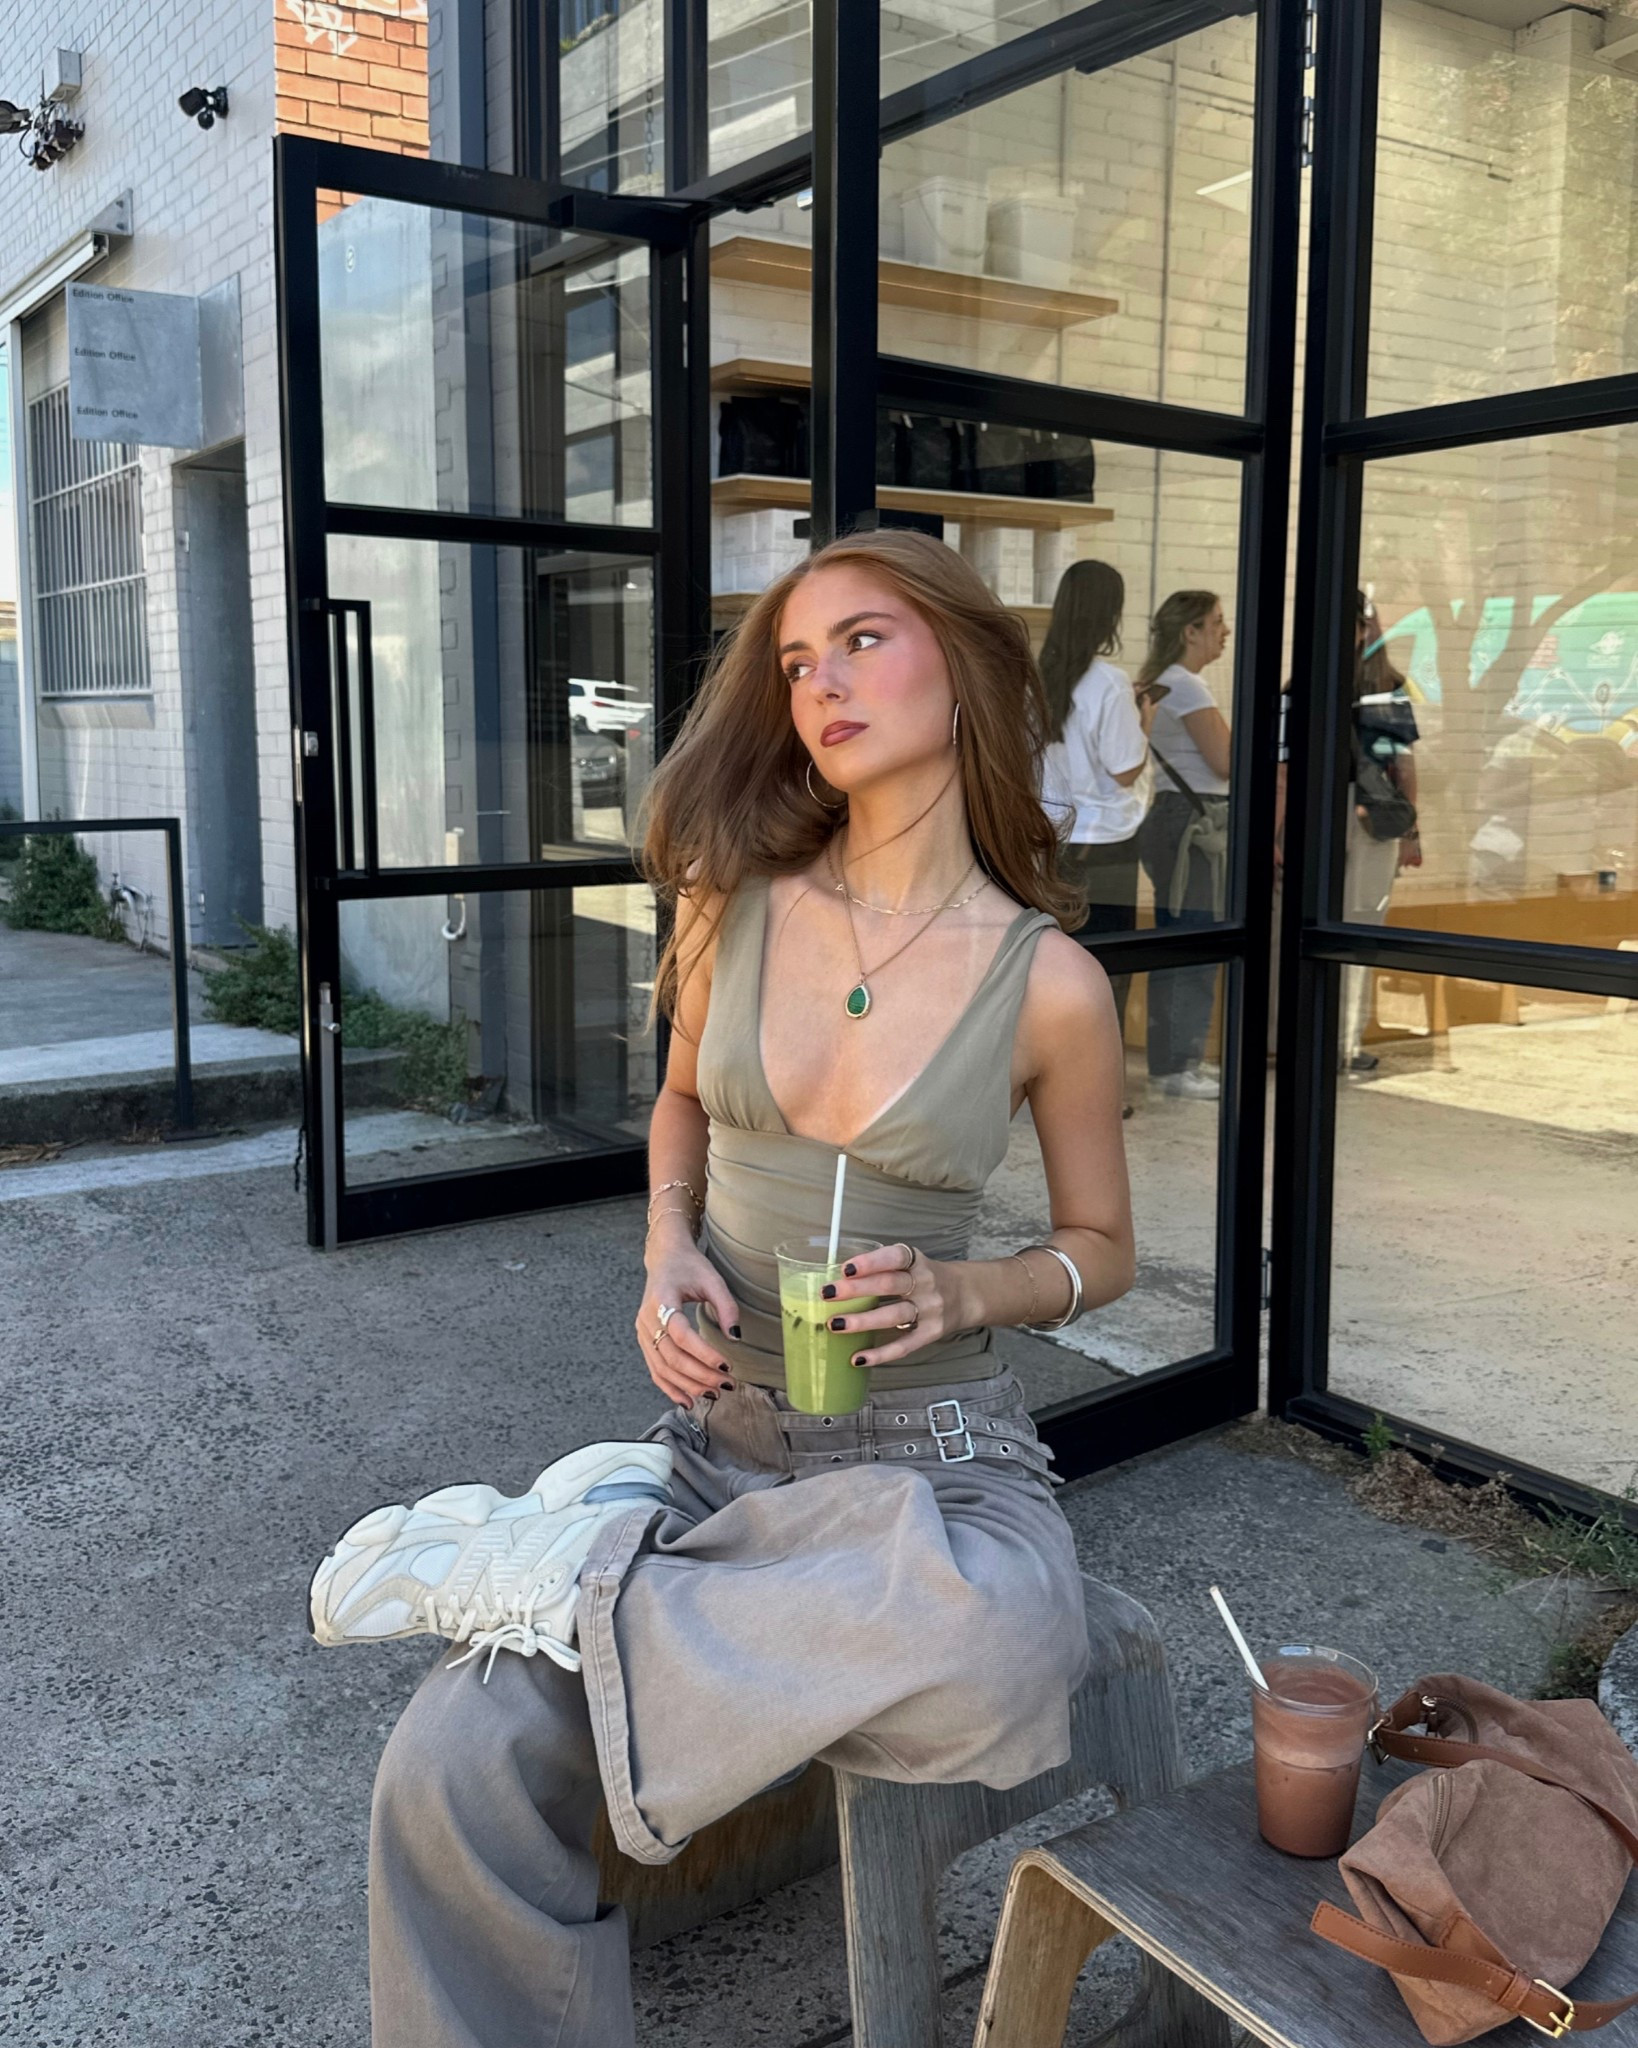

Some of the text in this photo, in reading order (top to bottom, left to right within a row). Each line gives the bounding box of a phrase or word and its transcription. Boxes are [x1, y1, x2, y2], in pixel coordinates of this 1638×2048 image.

[72, 288, 134, 304] Edition Office
[75, 347, 136, 362] Edition Office
[77, 406, 138, 420] Edition Office
[416, 1615, 426, 1623] N
